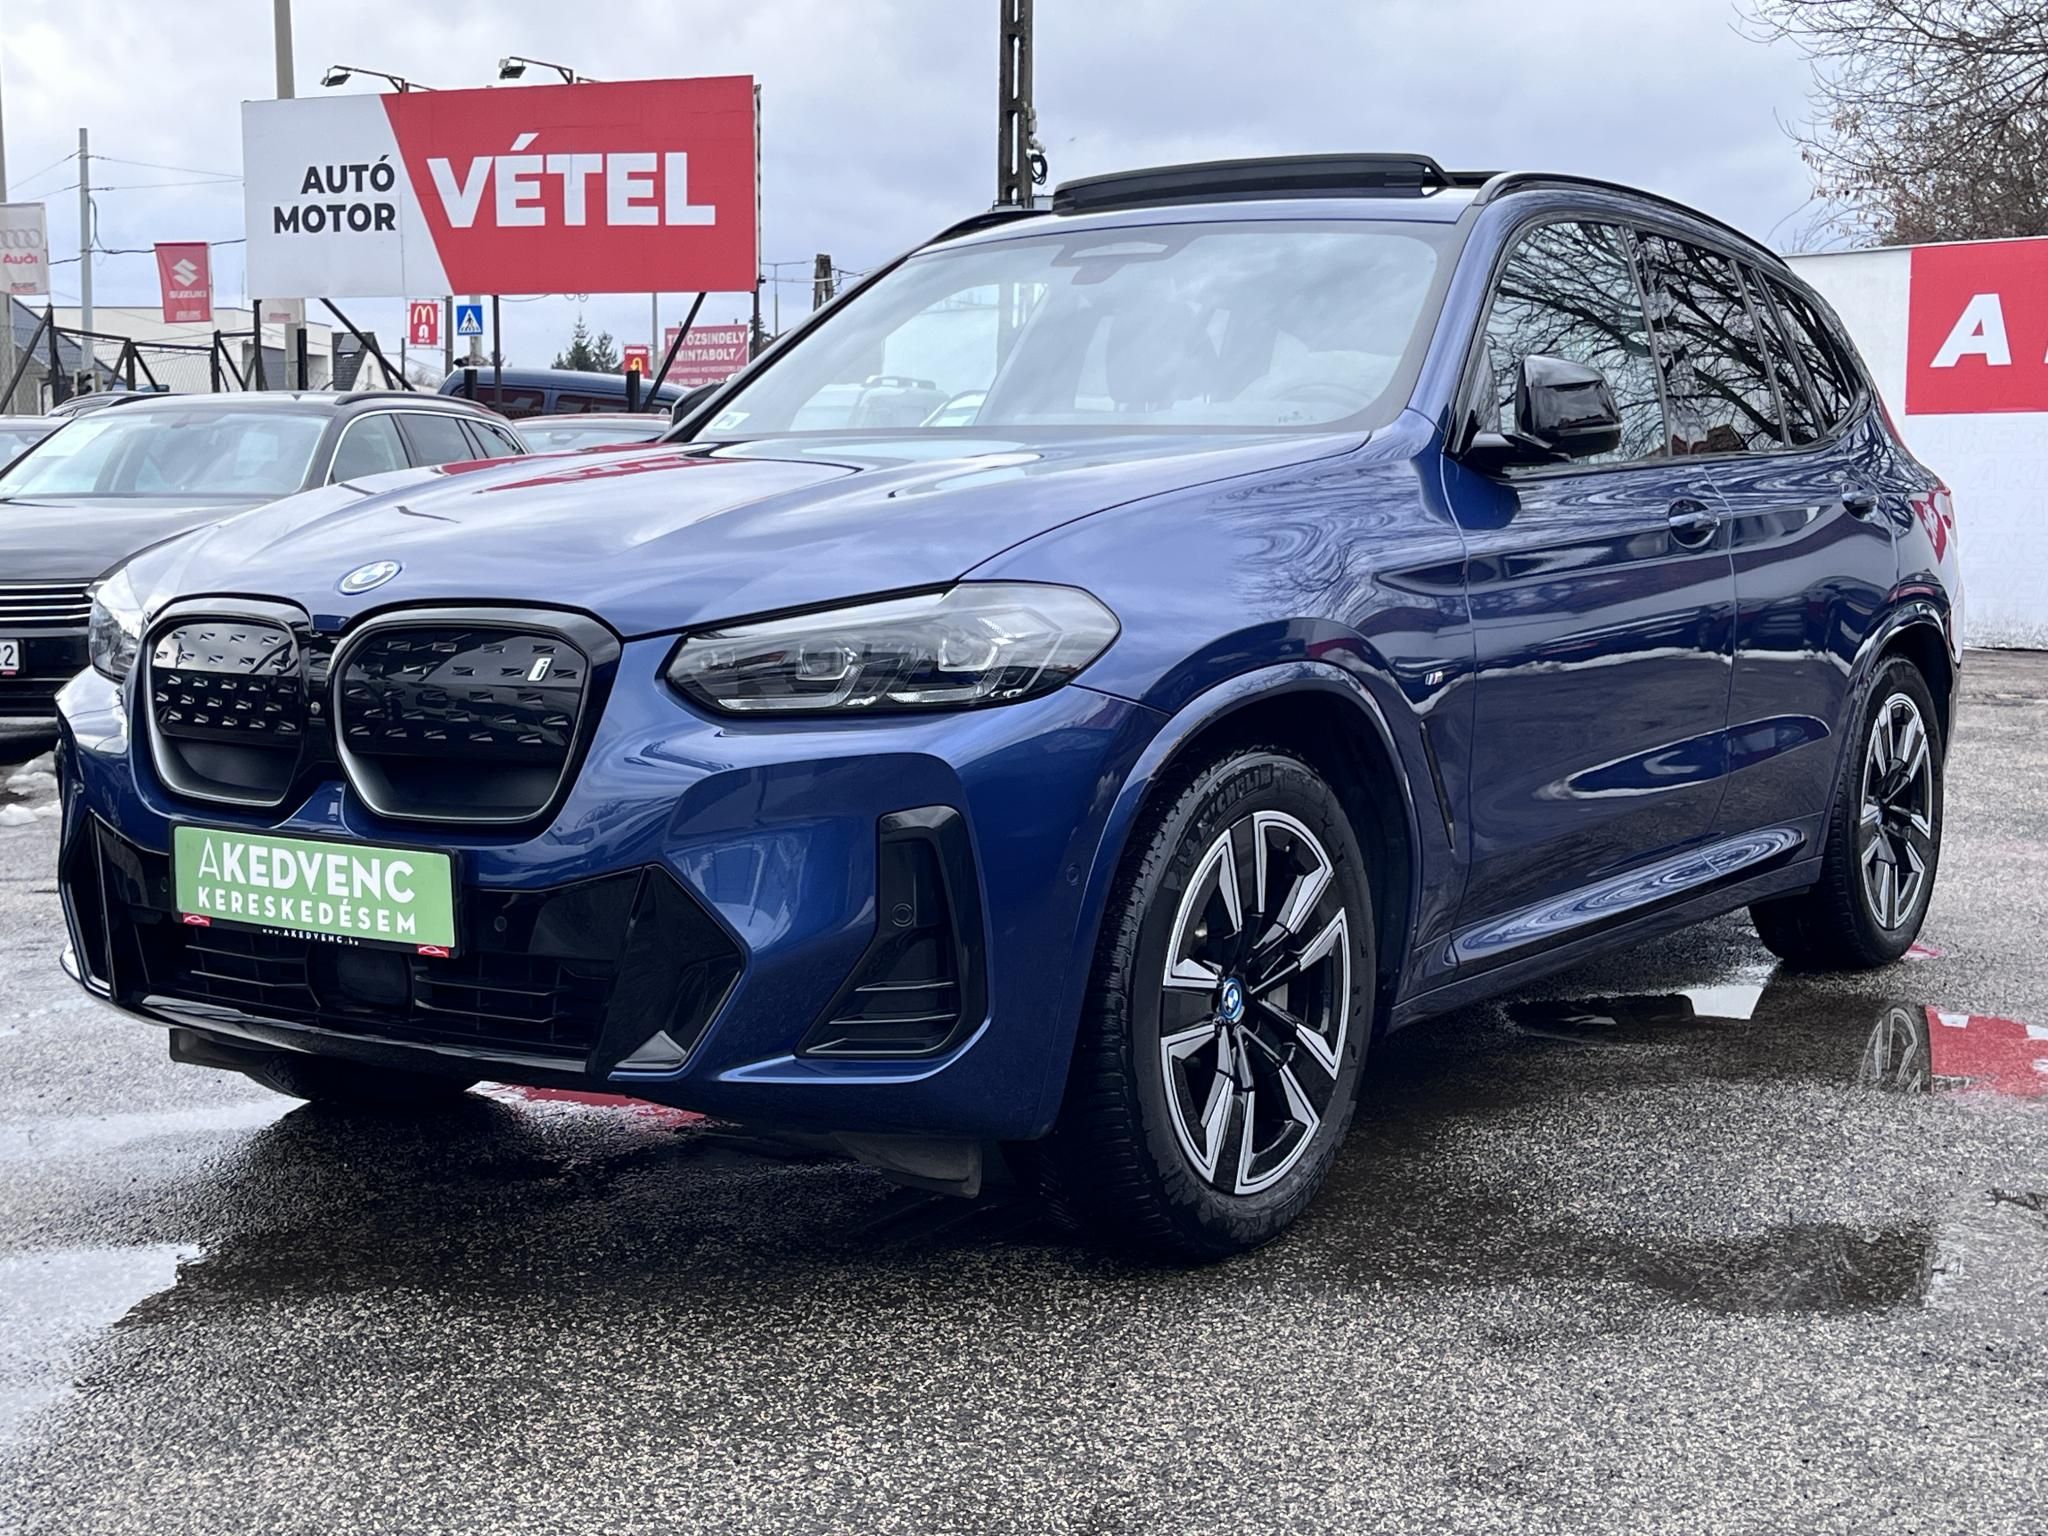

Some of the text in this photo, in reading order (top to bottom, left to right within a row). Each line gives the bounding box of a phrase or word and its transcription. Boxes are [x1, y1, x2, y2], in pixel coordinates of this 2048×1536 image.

[301, 154, 395, 194] AUTÓ
[427, 132, 716, 228] VÉTEL
[274, 203, 396, 233] MOTOR
[666, 330, 746, 347] TŐZSINDELY
[198, 886, 416, 935] KERESKEDÉSEM
